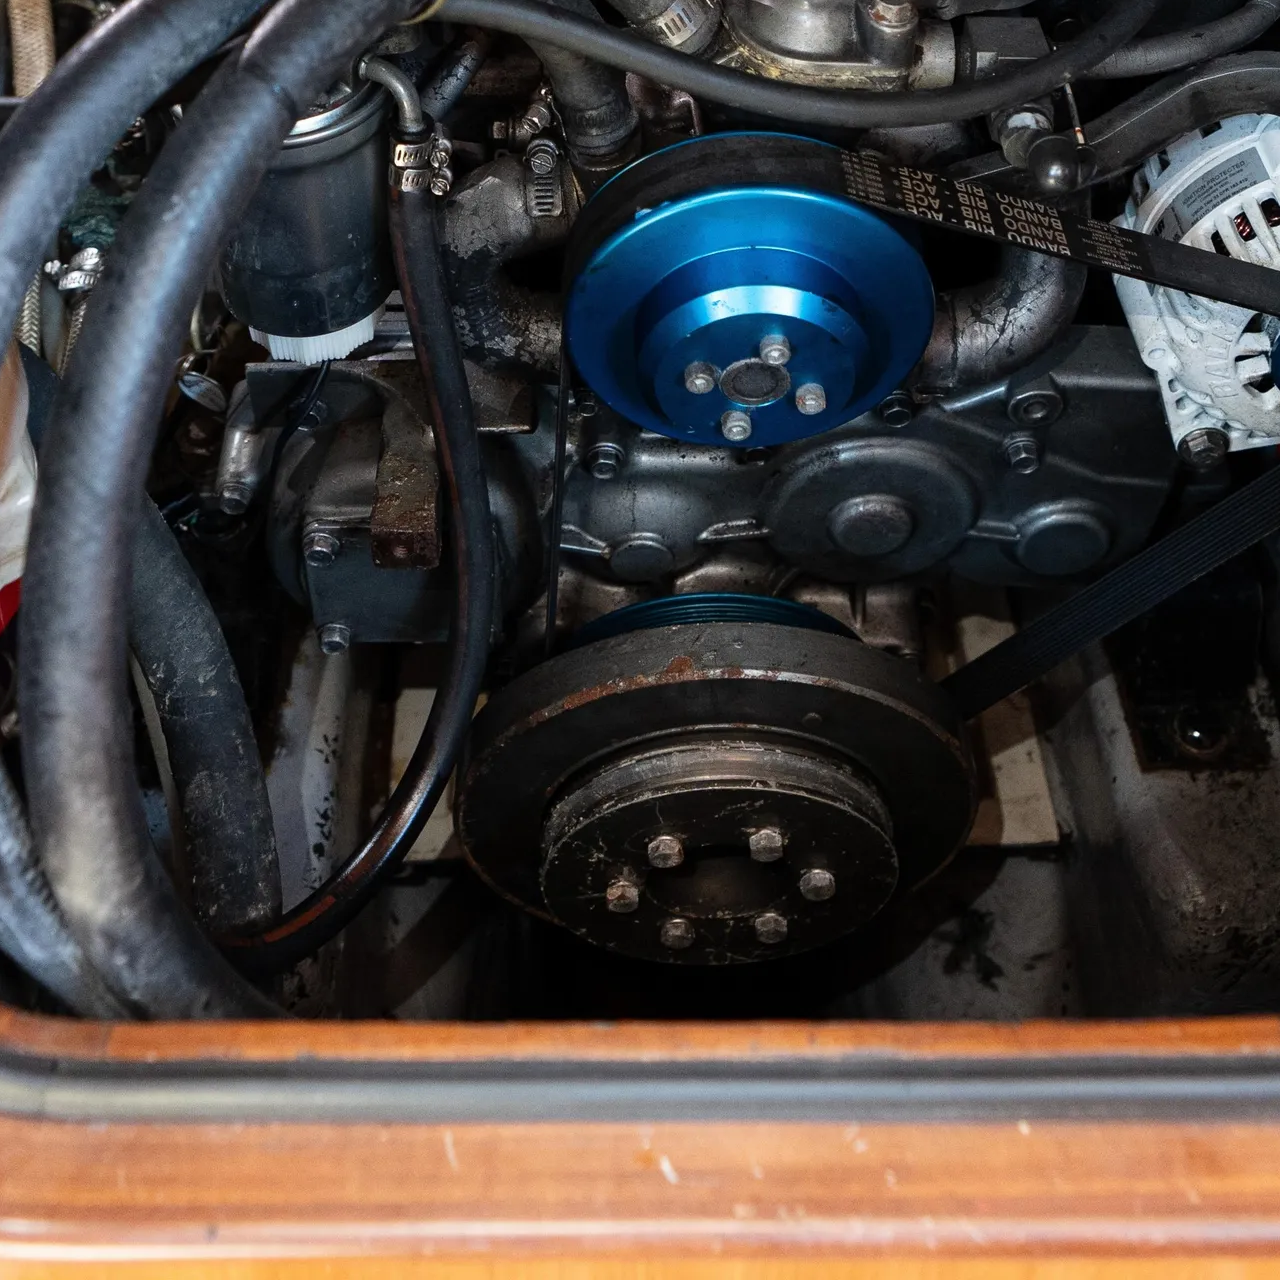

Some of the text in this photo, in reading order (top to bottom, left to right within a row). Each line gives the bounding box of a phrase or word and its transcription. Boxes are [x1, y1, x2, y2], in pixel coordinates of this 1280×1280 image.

[1182, 183, 1206, 205] IGNITION
[1206, 159, 1245, 185] PROTECTED
[957, 192, 988, 209] RIB
[960, 206, 991, 224] RIB
[1000, 204, 1063, 230] BANDO
[1004, 217, 1067, 243] BANDO
